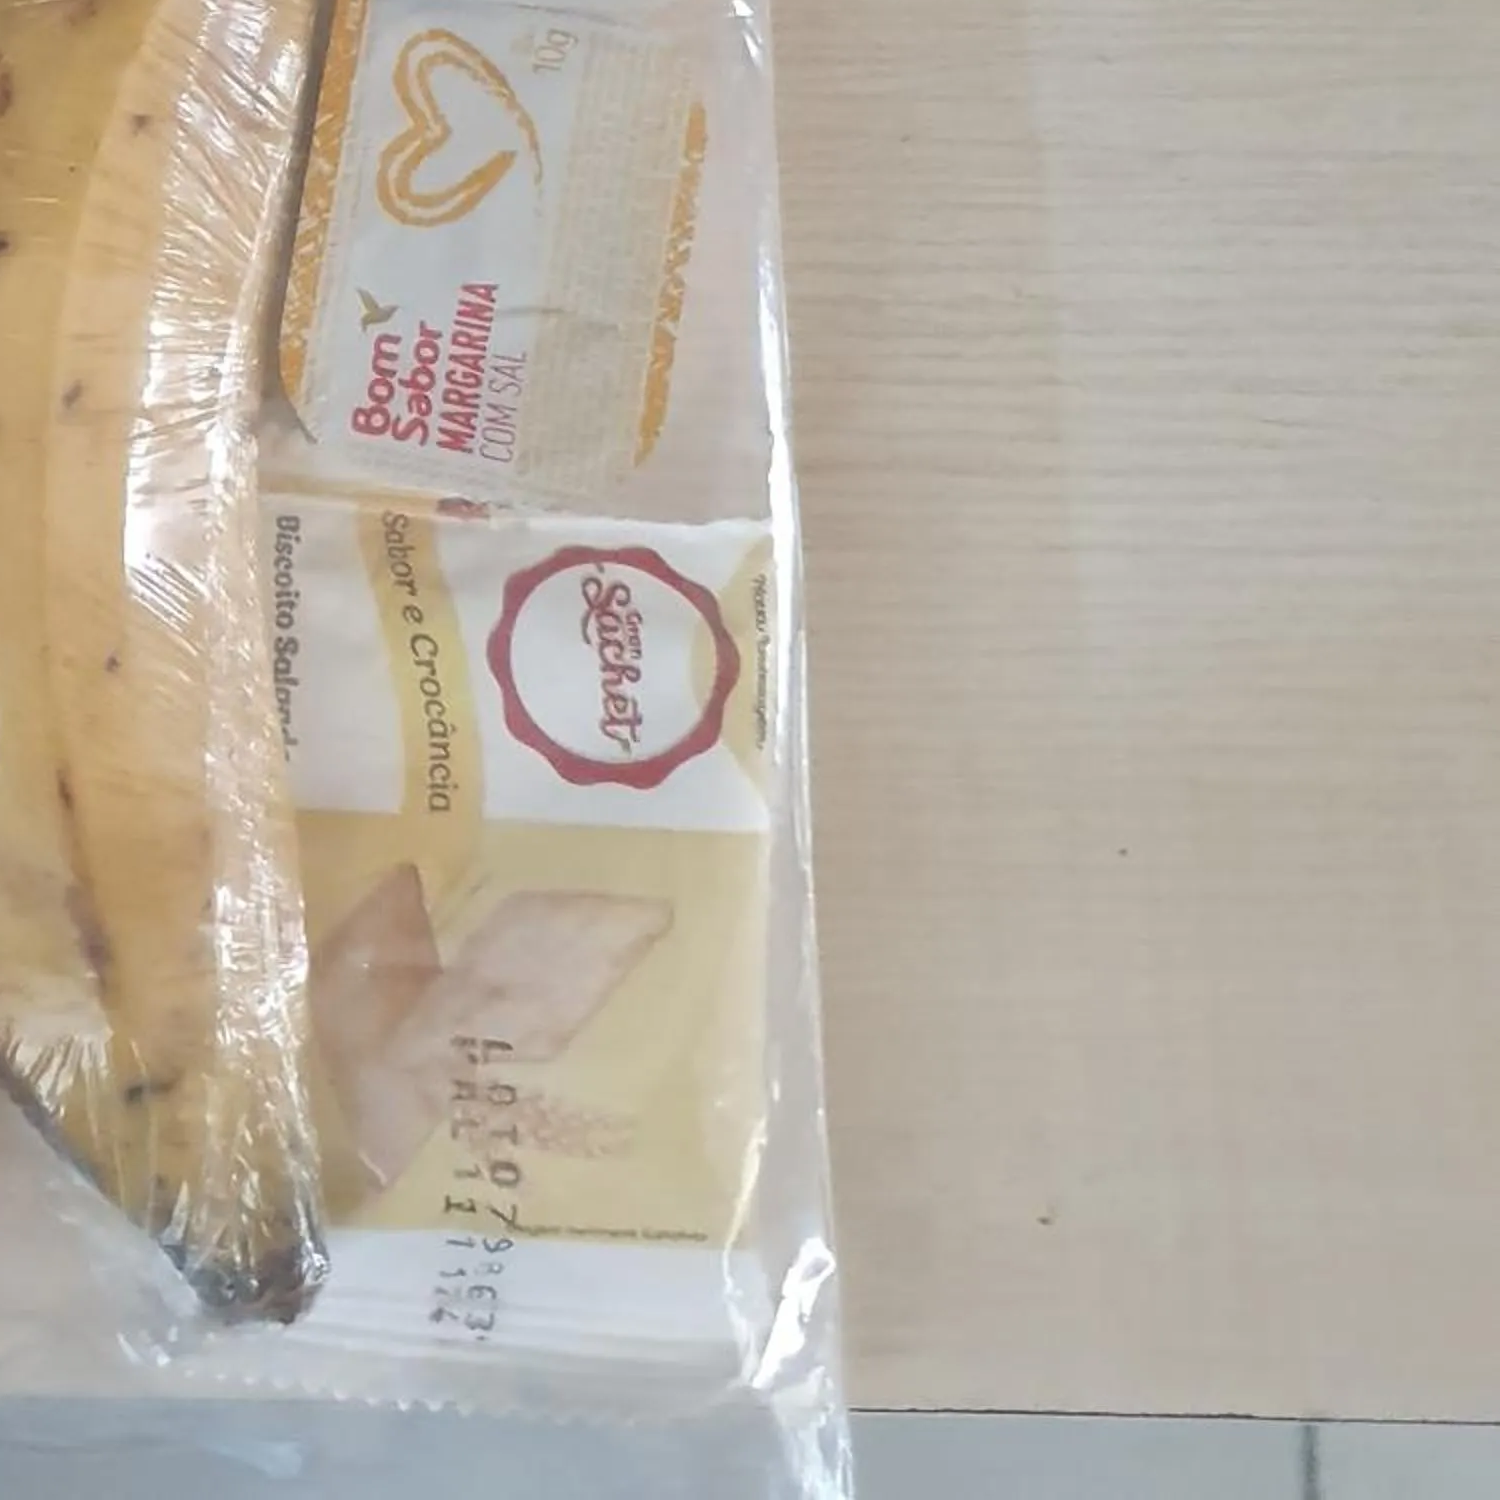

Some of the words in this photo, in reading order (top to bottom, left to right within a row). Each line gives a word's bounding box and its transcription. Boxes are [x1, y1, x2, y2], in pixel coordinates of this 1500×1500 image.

[531, 28, 579, 76] 10g
[352, 333, 403, 436] Bom
[391, 319, 443, 447] Sabor
[435, 282, 499, 453] MARGARINA
[488, 351, 528, 397] SAL
[479, 402, 517, 463] COM
[275, 516, 299, 631] Biscoito
[382, 511, 416, 596] Sabor
[402, 604, 423, 625] e
[582, 570, 644, 754] Sachet
[409, 632, 453, 813] Crocância
